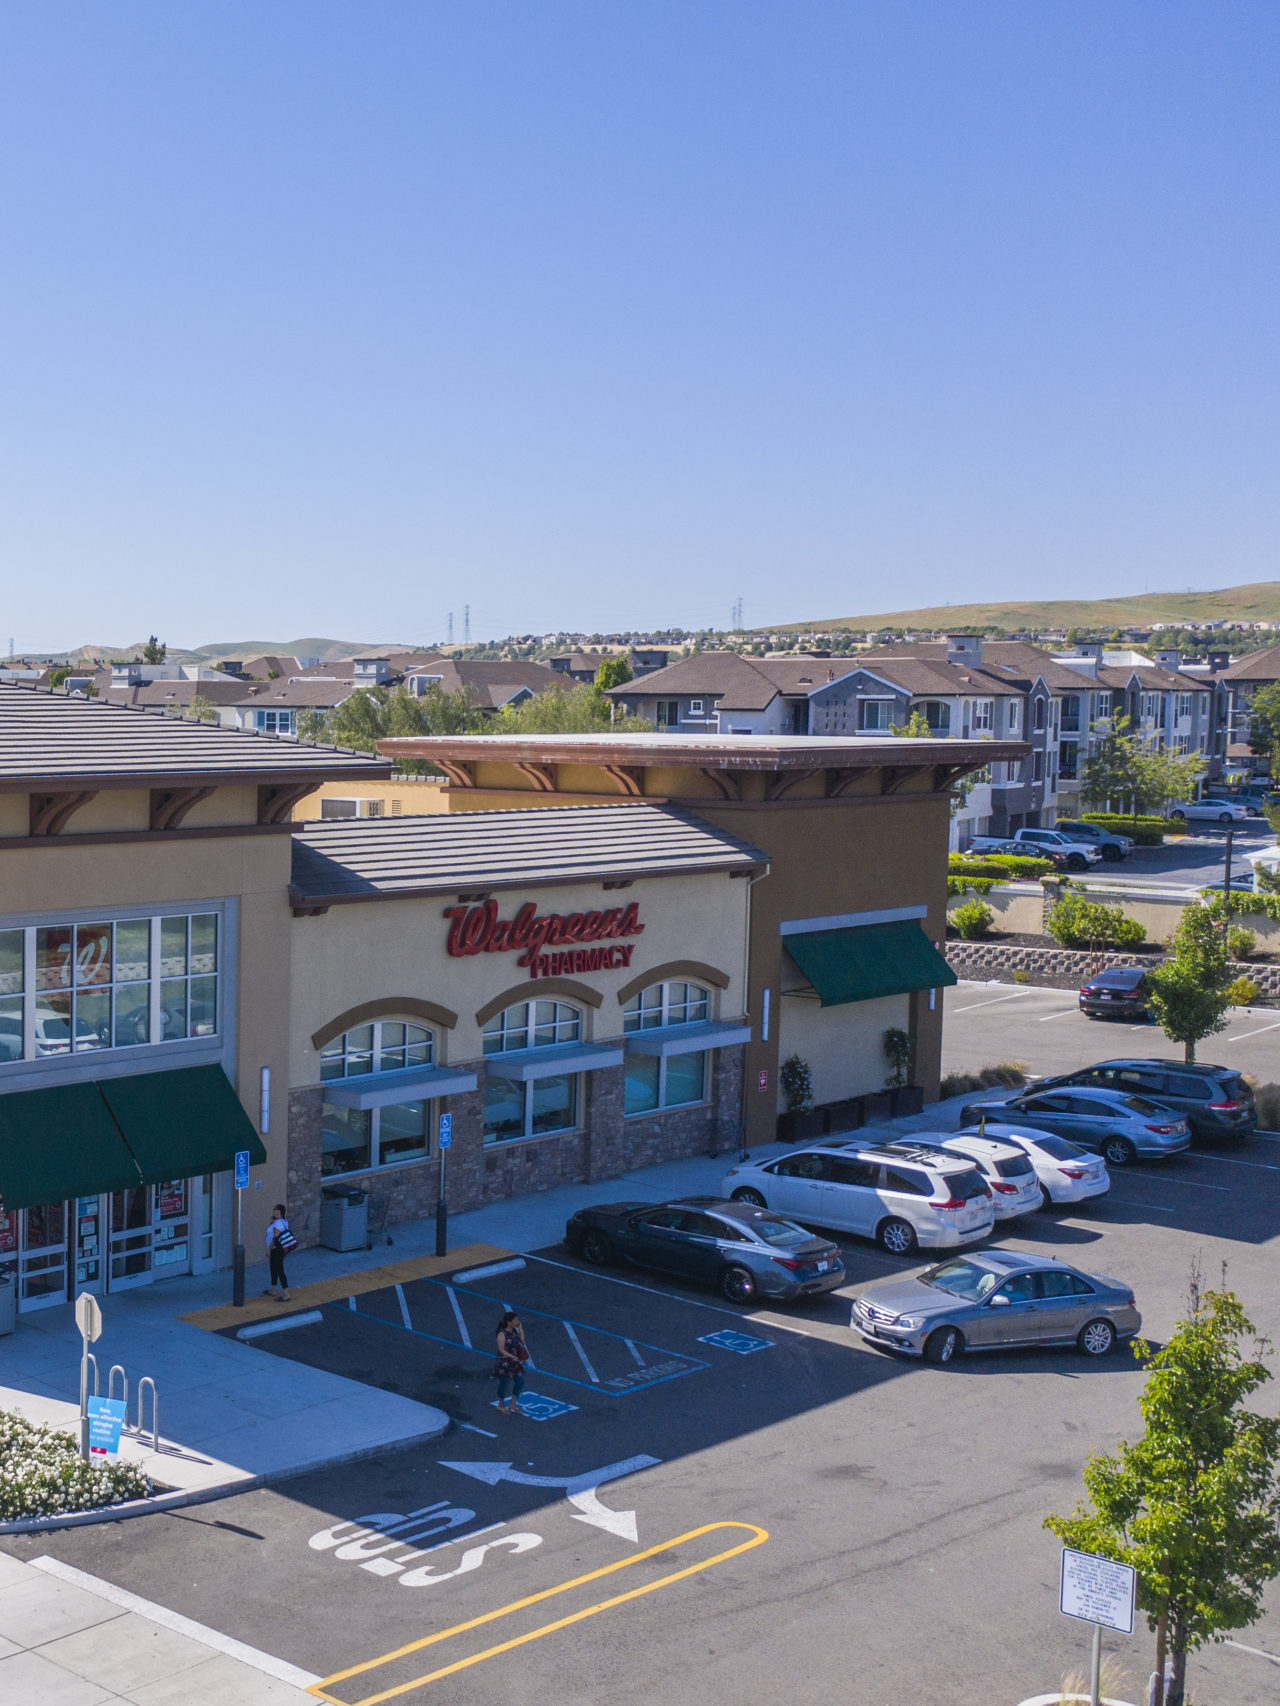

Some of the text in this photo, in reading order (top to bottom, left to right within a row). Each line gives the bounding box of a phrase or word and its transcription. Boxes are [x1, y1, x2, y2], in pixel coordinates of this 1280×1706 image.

[443, 899, 645, 967] Walgreens
[530, 945, 634, 978] PHARMACY
[308, 1500, 543, 1587] STOP
